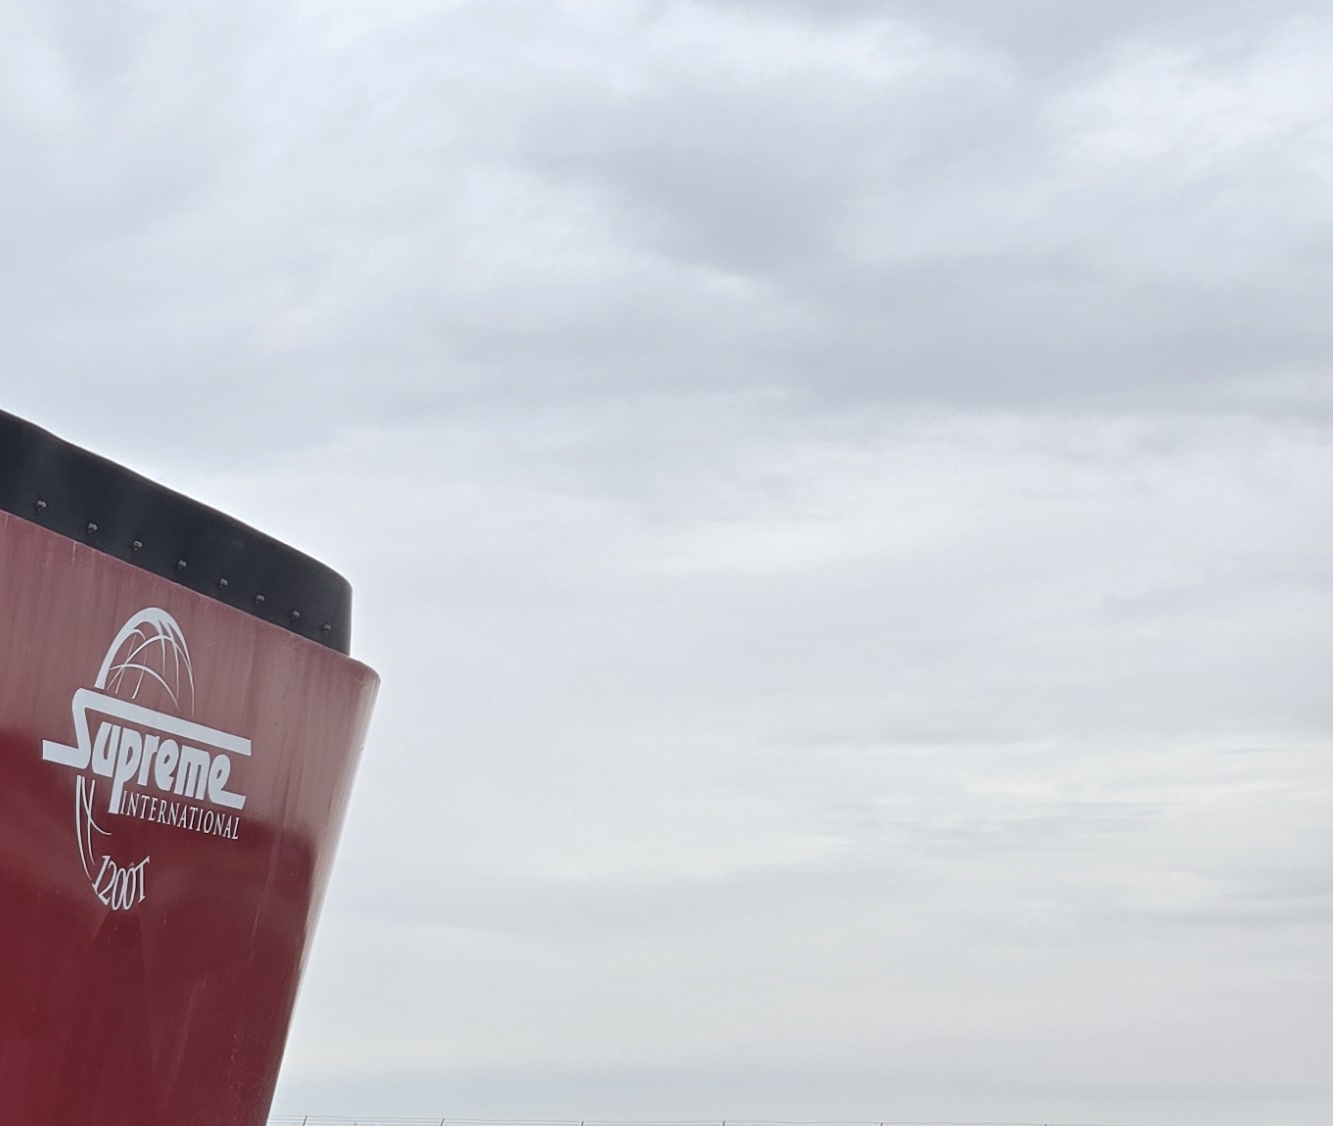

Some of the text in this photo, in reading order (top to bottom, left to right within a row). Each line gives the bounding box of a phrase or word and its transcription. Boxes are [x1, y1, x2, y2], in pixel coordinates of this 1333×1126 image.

[43, 688, 251, 813] Supreme
[120, 790, 240, 840] INTERNATIONAL
[91, 855, 150, 911] 1200T
